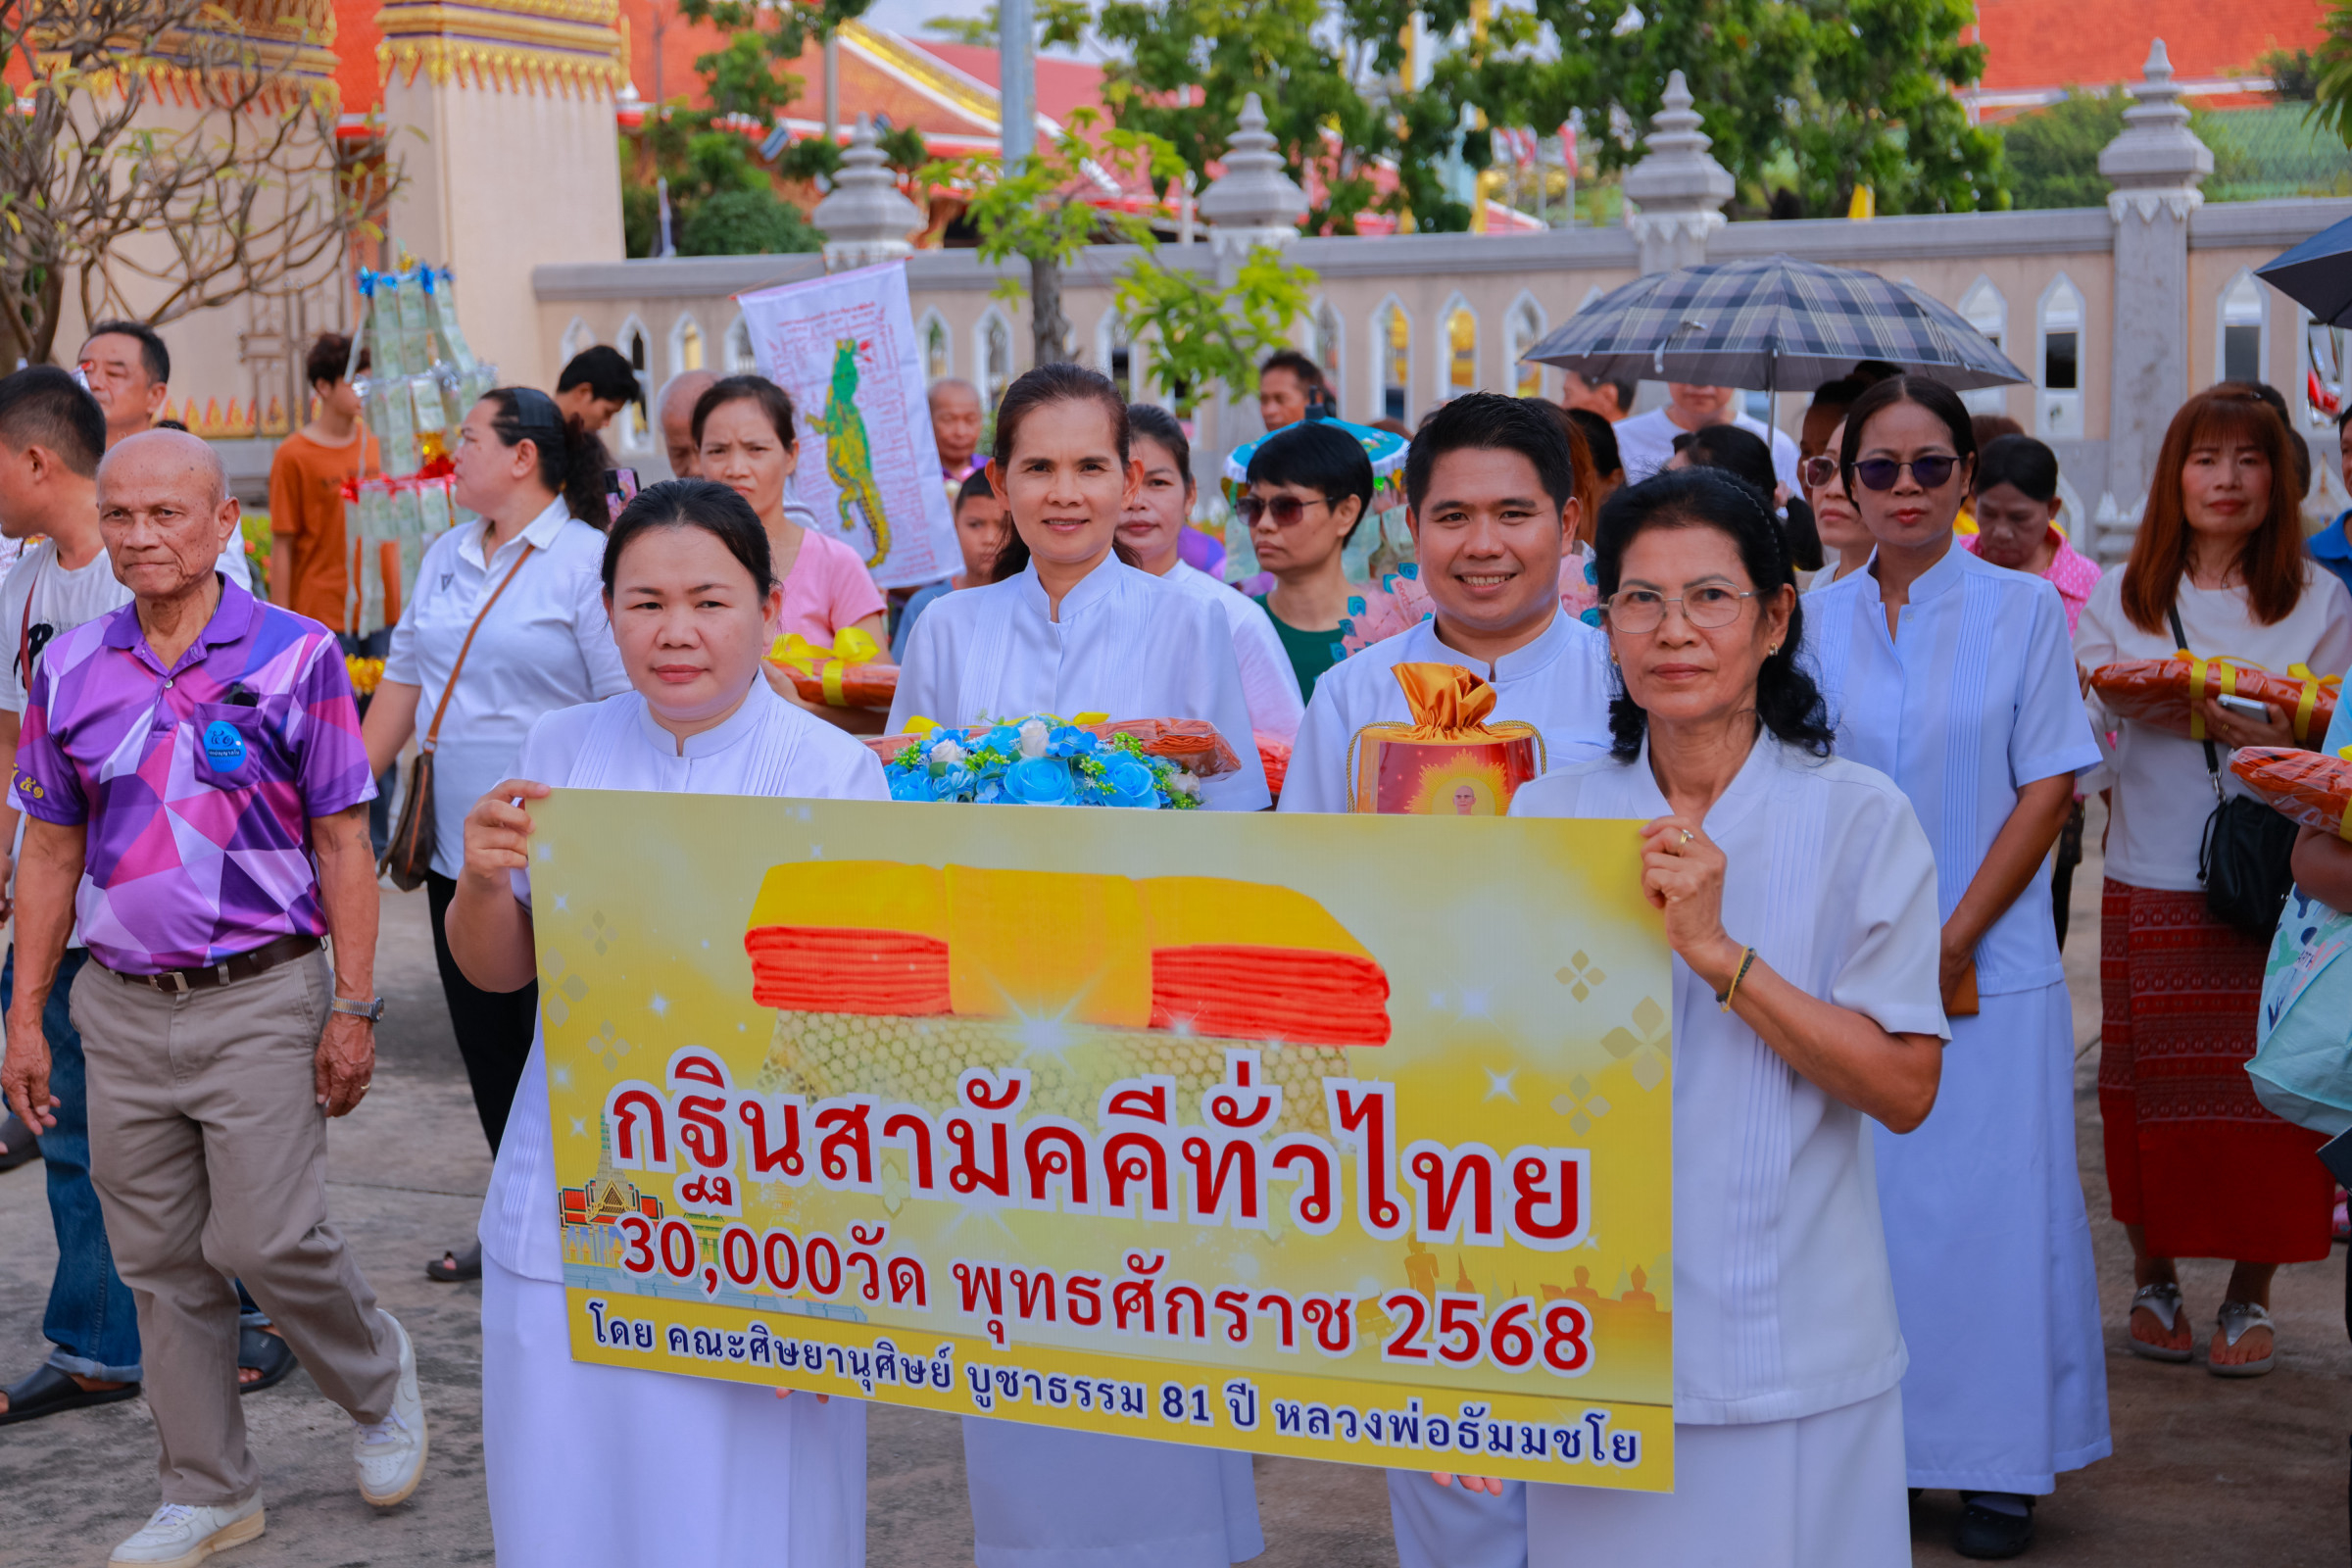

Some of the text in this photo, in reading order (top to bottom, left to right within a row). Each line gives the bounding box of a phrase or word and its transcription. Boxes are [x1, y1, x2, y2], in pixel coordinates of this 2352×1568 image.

[612, 1055, 1579, 1240] กฐินสามัคคีทั่วไทย
[621, 1217, 1589, 1371] 30,000วัด พุทธศักราช 2568
[588, 1301, 1637, 1464] โดย คณะศิษยานุศิษย์ บูชาธรรม 81 ปี หลวงพ่อธัมมชโย
